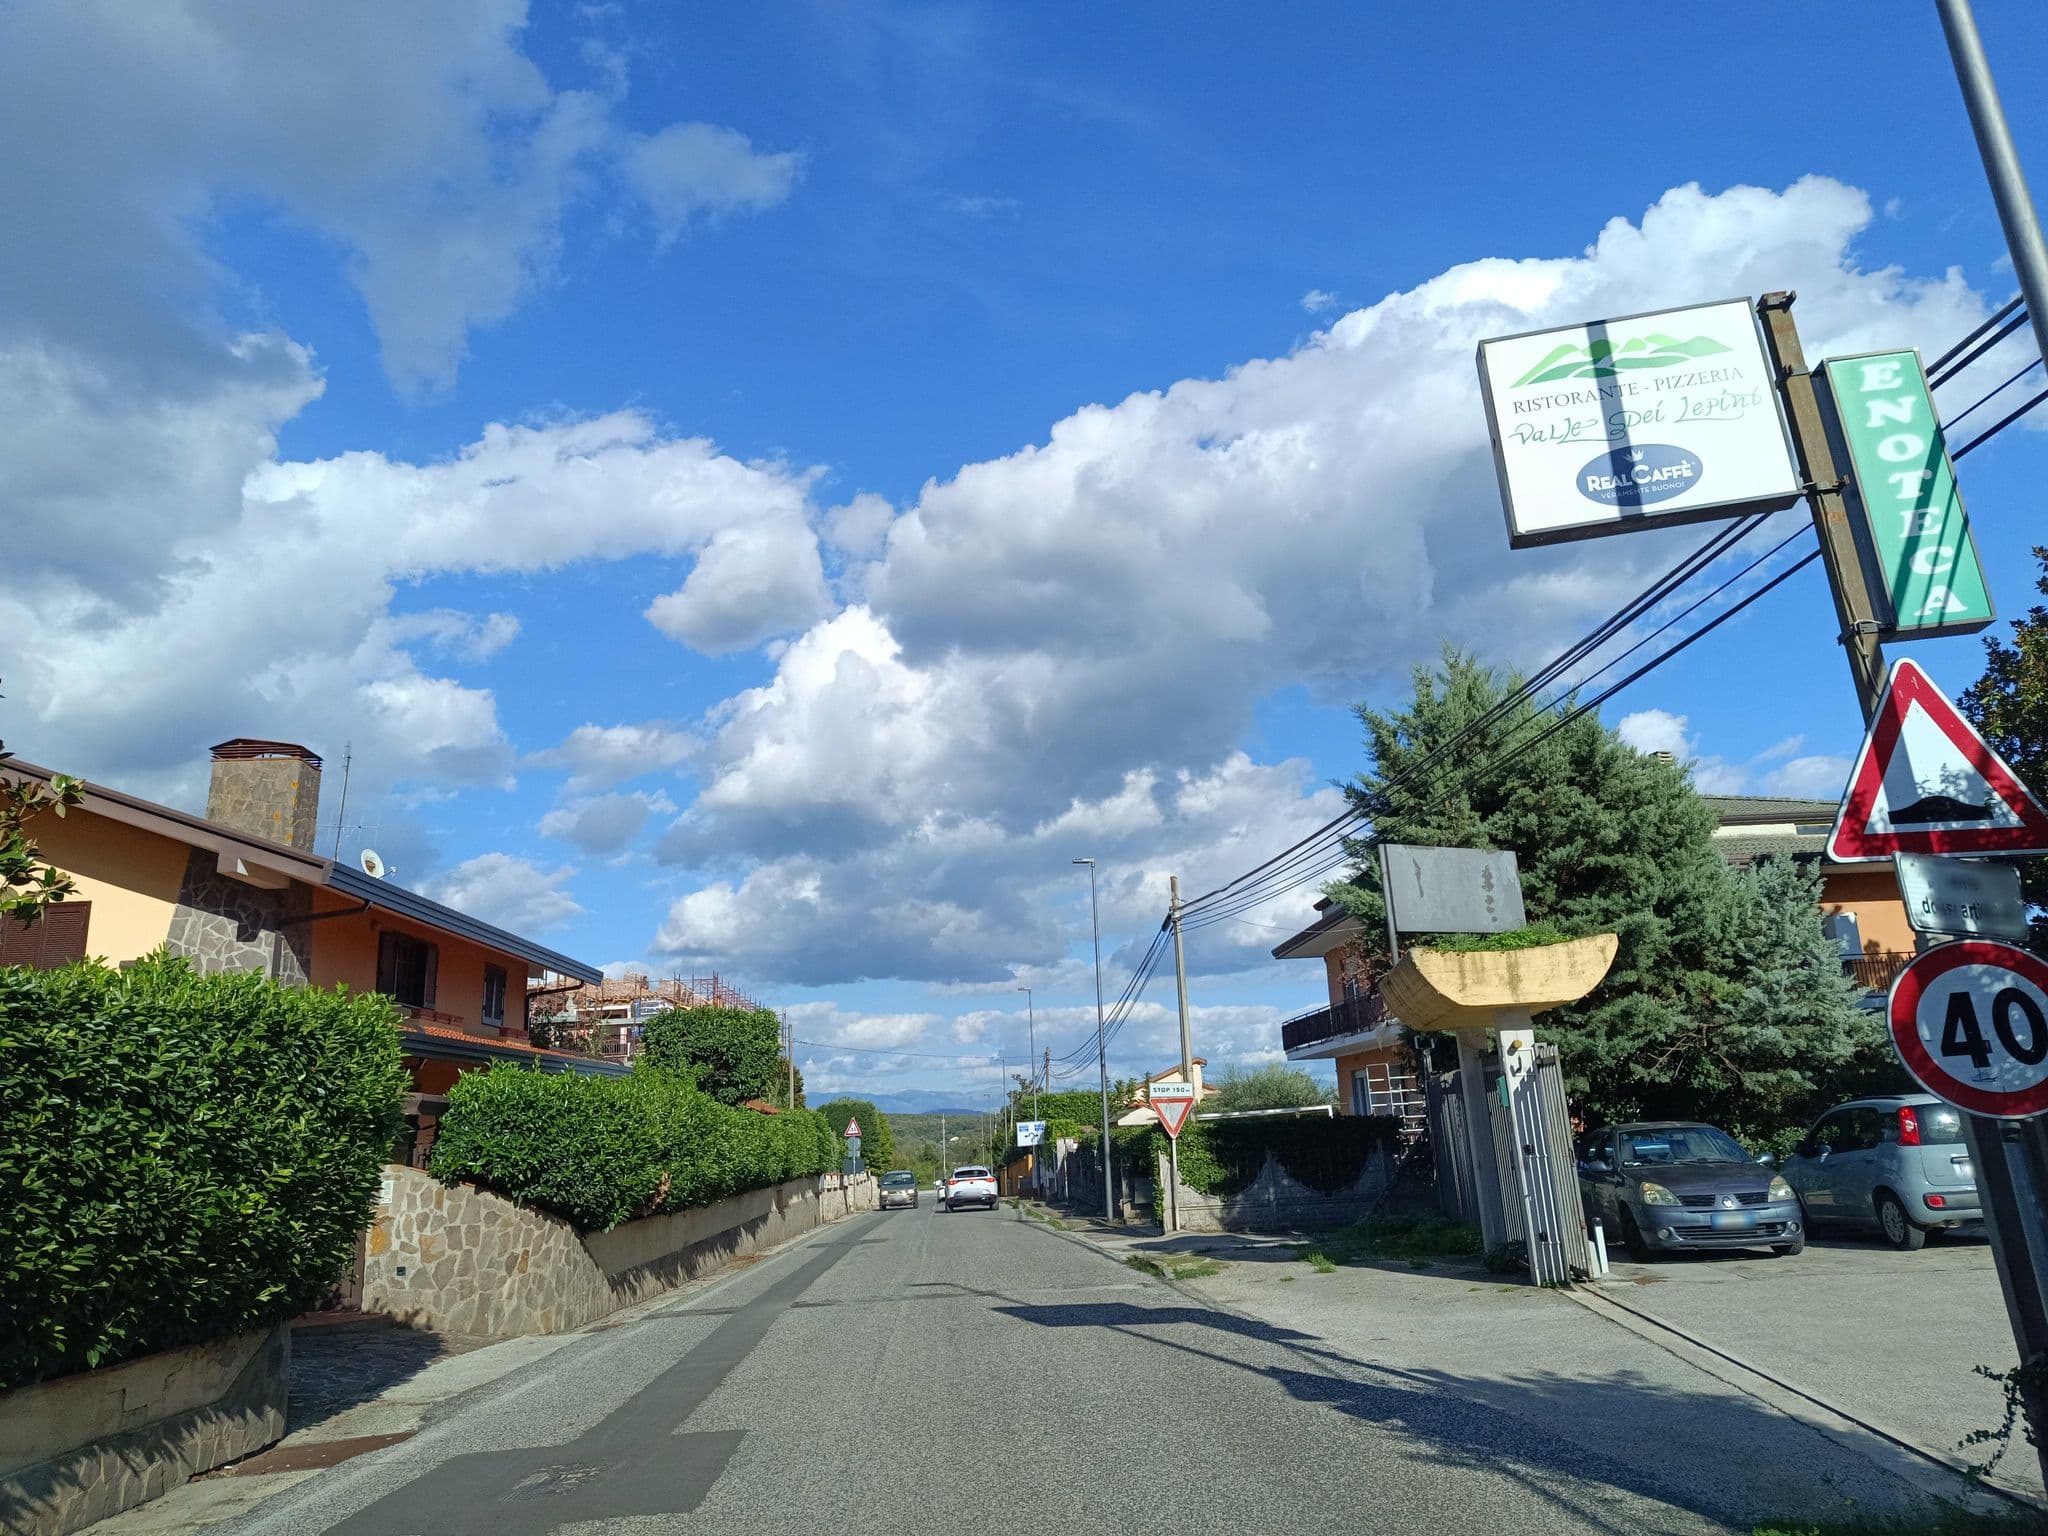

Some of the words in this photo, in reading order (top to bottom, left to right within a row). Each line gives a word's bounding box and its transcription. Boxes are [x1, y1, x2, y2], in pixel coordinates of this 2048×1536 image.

[1513, 383, 1640, 414] RISTORANTE
[1655, 367, 1744, 392] PIZZERIA
[1600, 487, 1650, 499] VERAMENTE
[1859, 361, 1968, 616] ENOTECA
[1941, 987, 2048, 1068] 40
